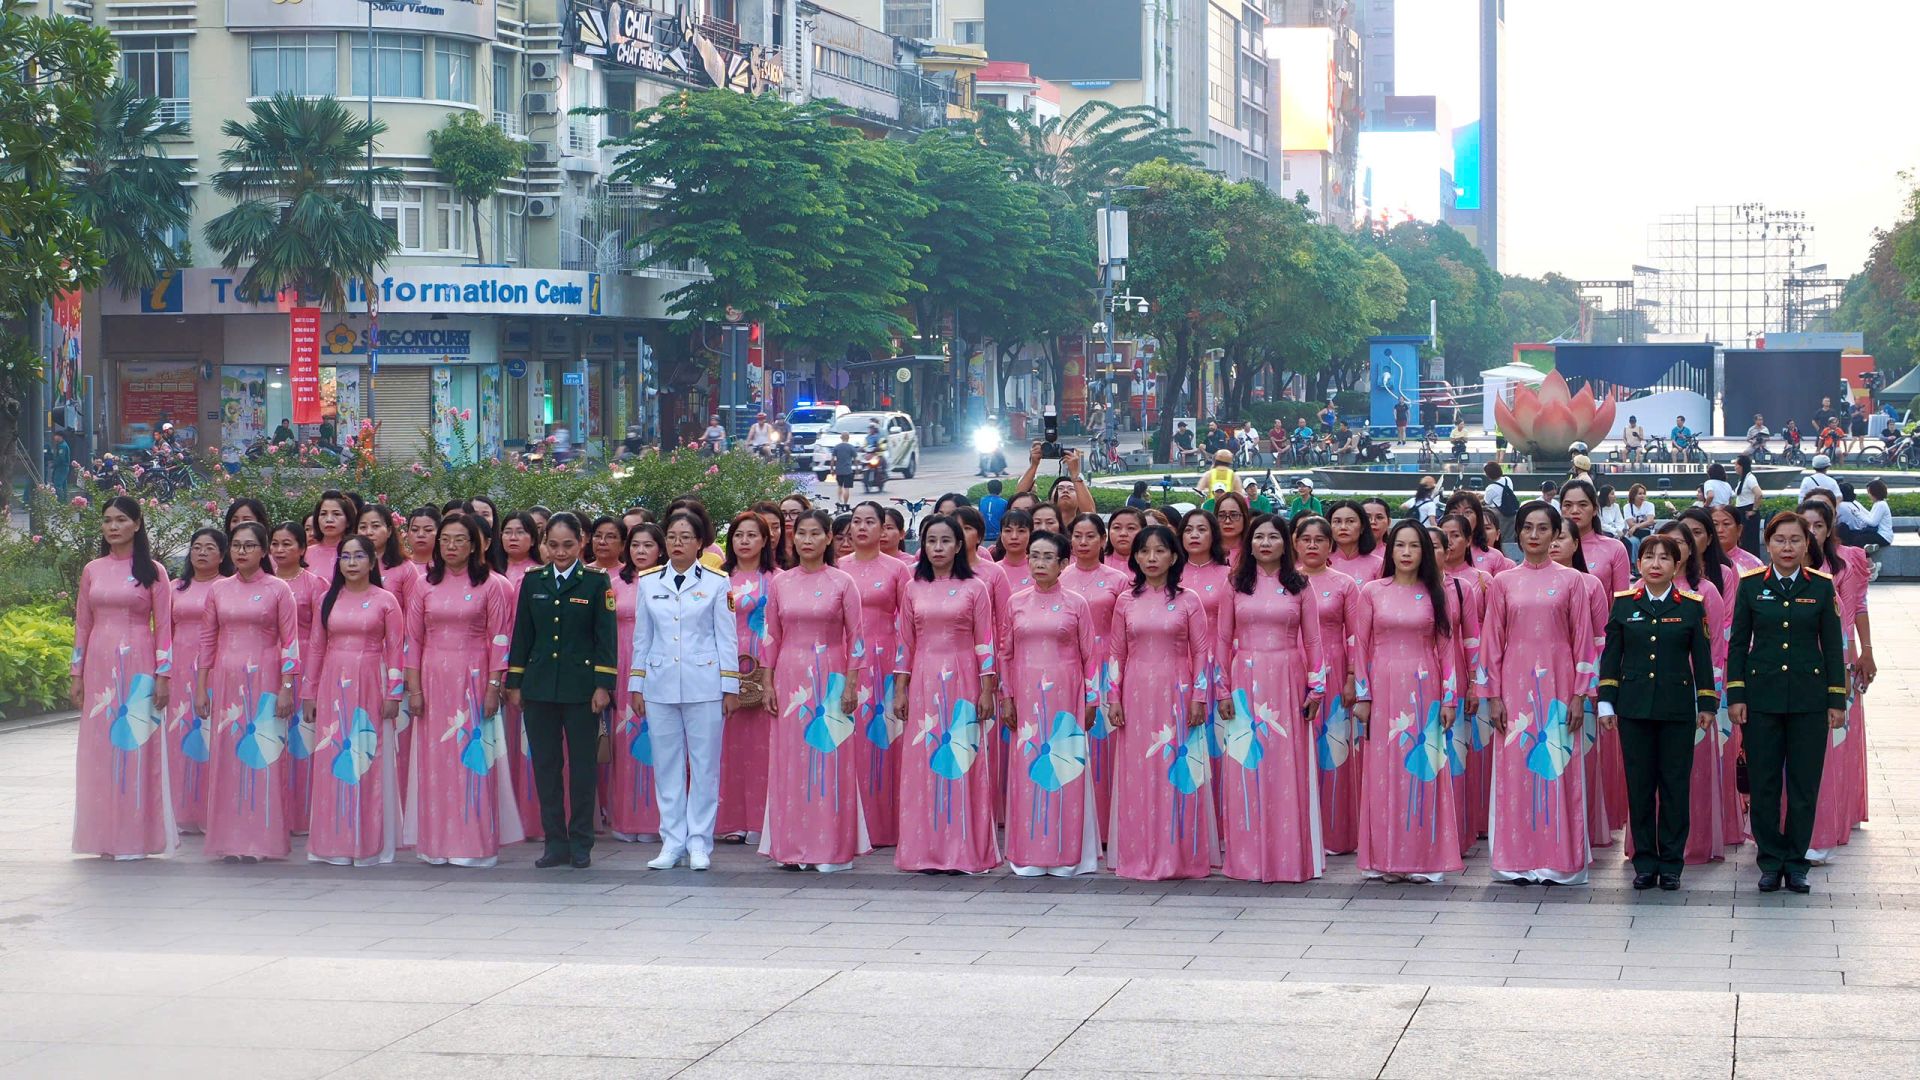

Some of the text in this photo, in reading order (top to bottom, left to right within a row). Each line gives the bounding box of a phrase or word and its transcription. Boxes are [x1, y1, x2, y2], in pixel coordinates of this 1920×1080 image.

[408, 3, 445, 16] Vietnam
[624, 9, 655, 43] CHILL
[638, 46, 664, 73] RIÊNG
[349, 276, 528, 305] Information
[535, 278, 583, 305] Center
[360, 329, 471, 347] SIGONTOURIST
